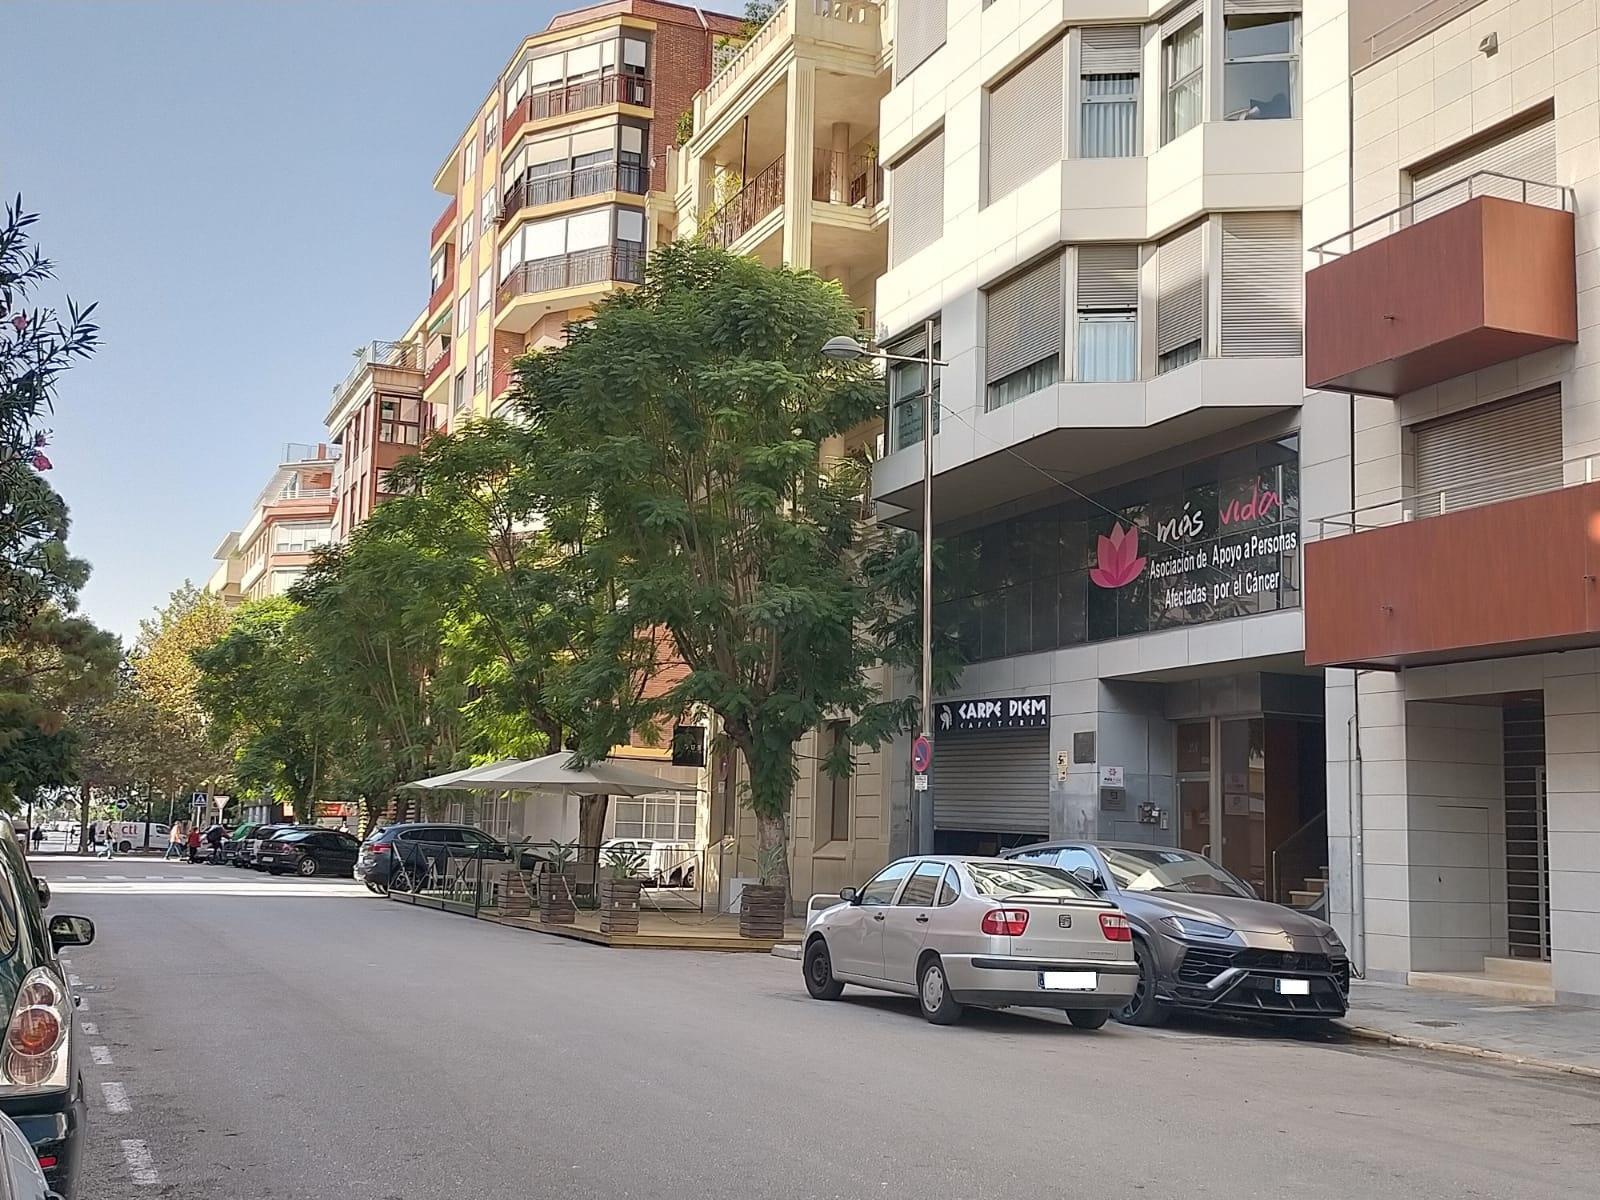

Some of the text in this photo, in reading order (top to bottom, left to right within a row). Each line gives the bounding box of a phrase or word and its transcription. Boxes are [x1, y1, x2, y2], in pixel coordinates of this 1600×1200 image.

[1157, 477, 1282, 543] más vida
[1150, 532, 1297, 579] Asociación de Apoyo a Personas
[1165, 571, 1280, 609] Afectadas por el Cáncer
[958, 699, 1046, 720] CARPE DIEM
[960, 719, 1046, 729] CAFETERIA
